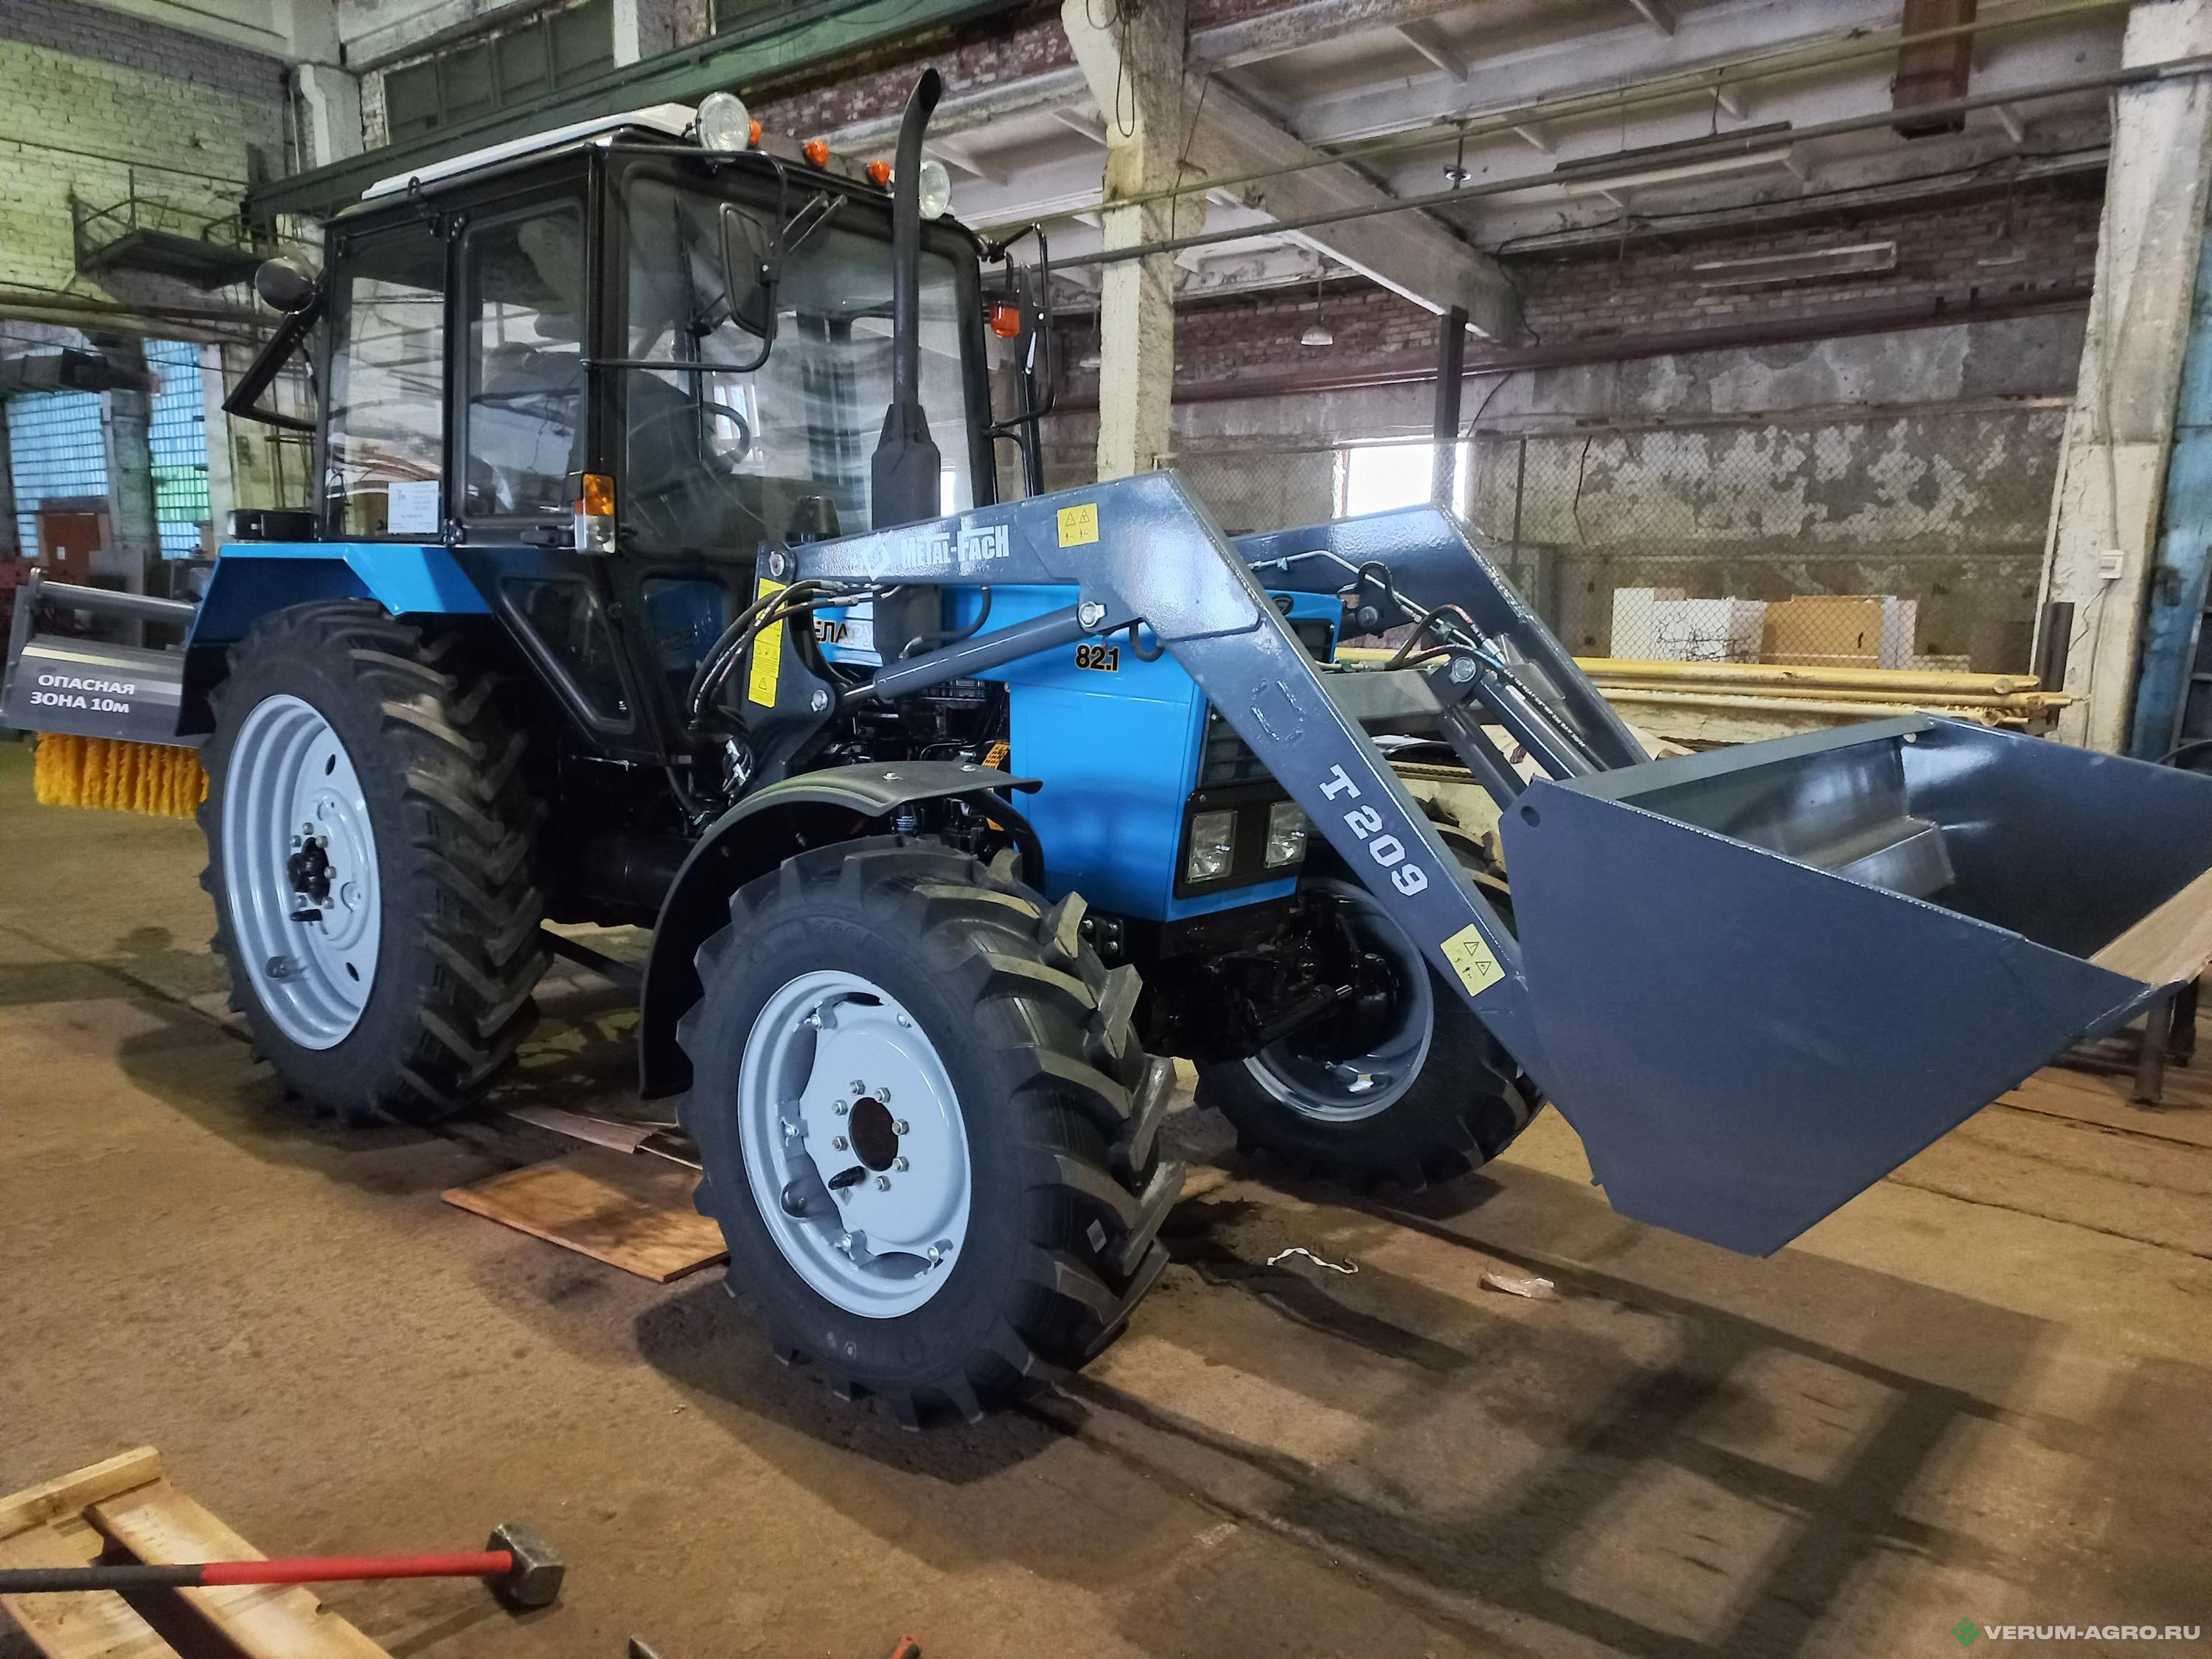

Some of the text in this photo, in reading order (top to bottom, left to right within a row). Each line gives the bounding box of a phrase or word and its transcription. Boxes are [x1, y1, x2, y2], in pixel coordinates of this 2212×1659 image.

[1074, 643, 1120, 672] 82.1
[38, 674, 135, 695] ОПАСНАЯ
[29, 691, 87, 709] ЗОНА
[1319, 764, 1429, 897] T 209
